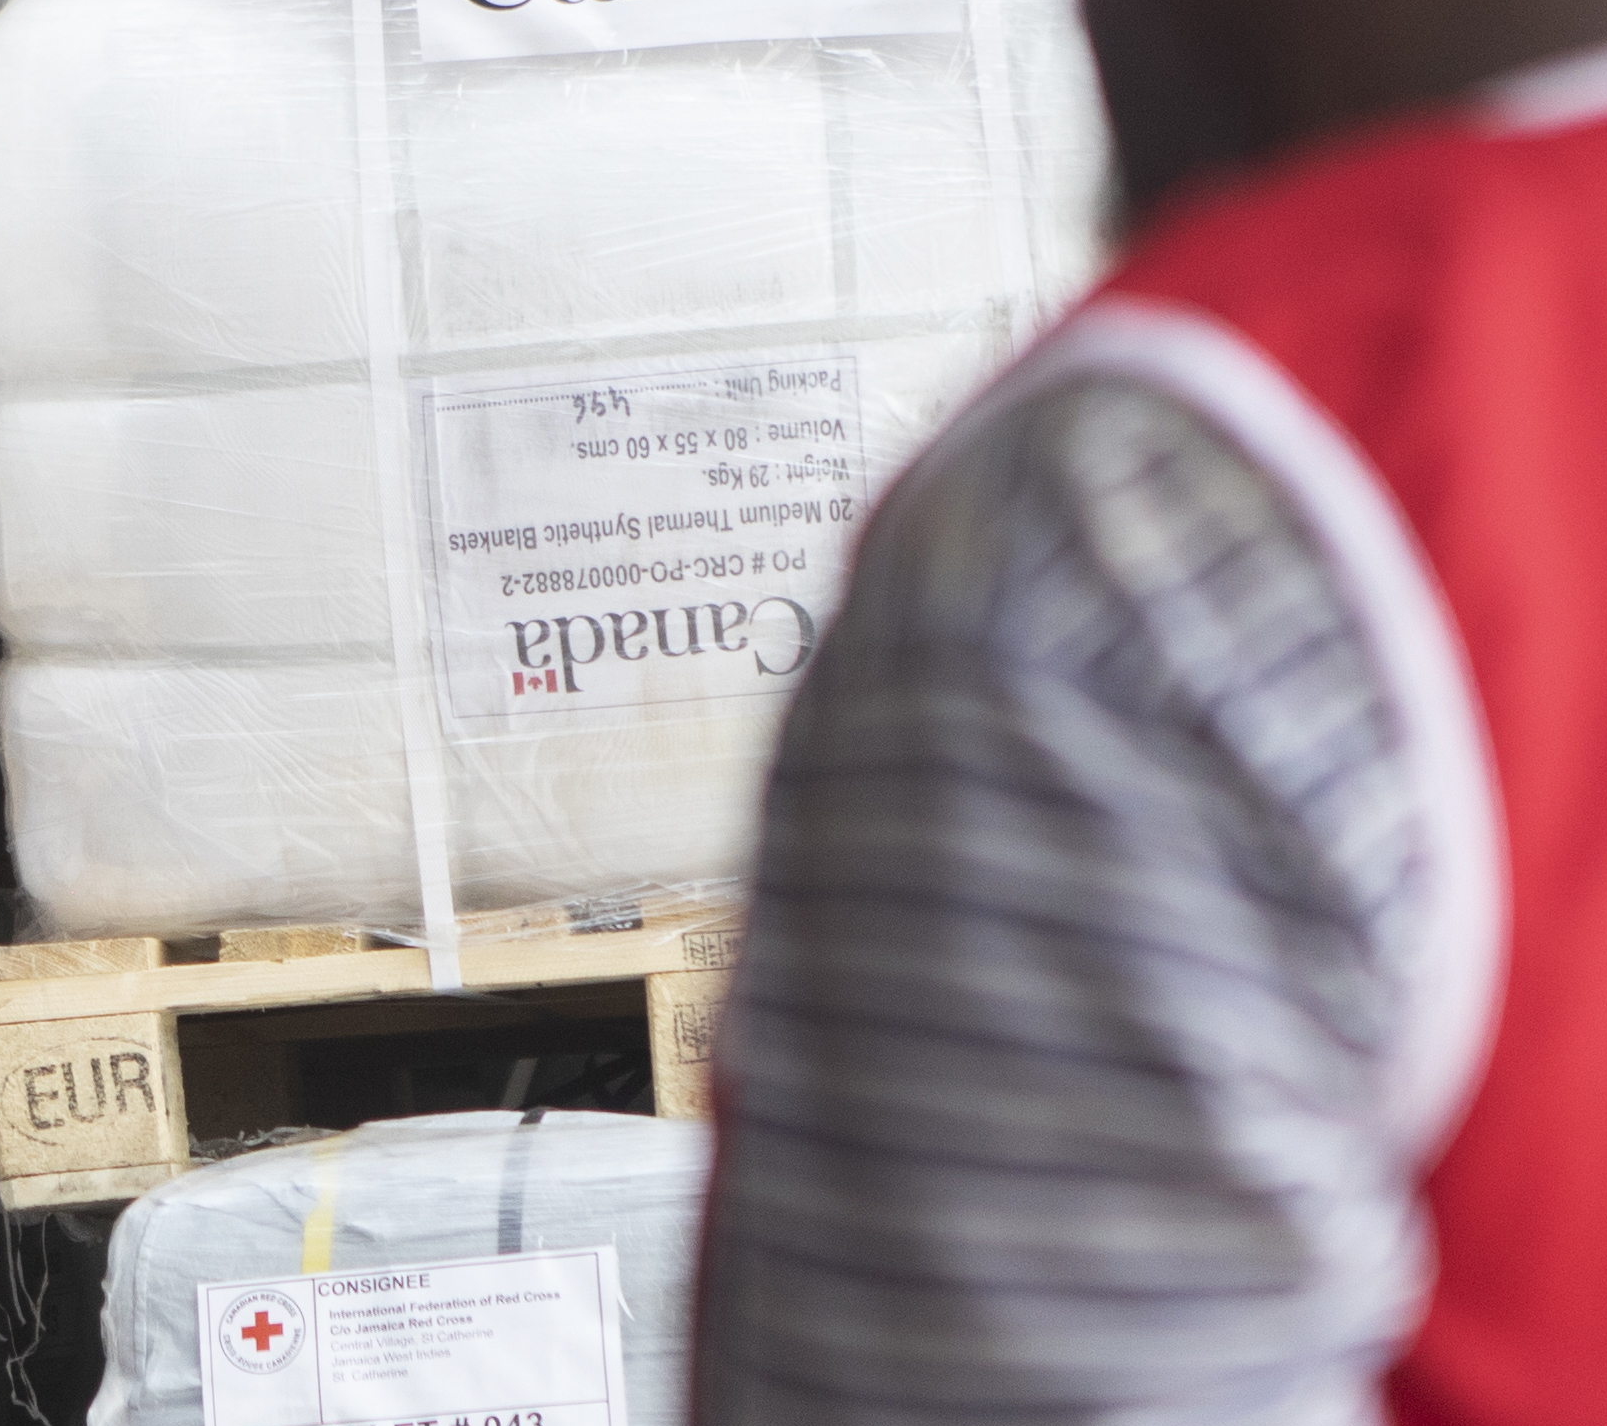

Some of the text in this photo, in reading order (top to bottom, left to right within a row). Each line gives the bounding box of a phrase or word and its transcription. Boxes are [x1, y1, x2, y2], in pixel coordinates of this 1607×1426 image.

[767, 368, 842, 393] Packing
[569, 417, 846, 462] Volume 80 x 55 x 60 cms.
[701, 465, 744, 490] Kgs.
[748, 463, 770, 488] 29
[448, 497, 855, 553] 20 Medium Thermal Synthetic Blankets
[500, 547, 807, 598] PO # CRC-PO-000078882-2
[504, 594, 817, 694] Canada
[22, 1050, 160, 1132] EUR
[317, 1273, 431, 1298] CONSIGNEE
[329, 1290, 562, 1321] International Federation of Red Cross
[354, 1320, 406, 1336] Jamaica
[408, 1318, 433, 1330] Red
[436, 1314, 474, 1328] Cross
[436, 1328, 495, 1344] Catherine
